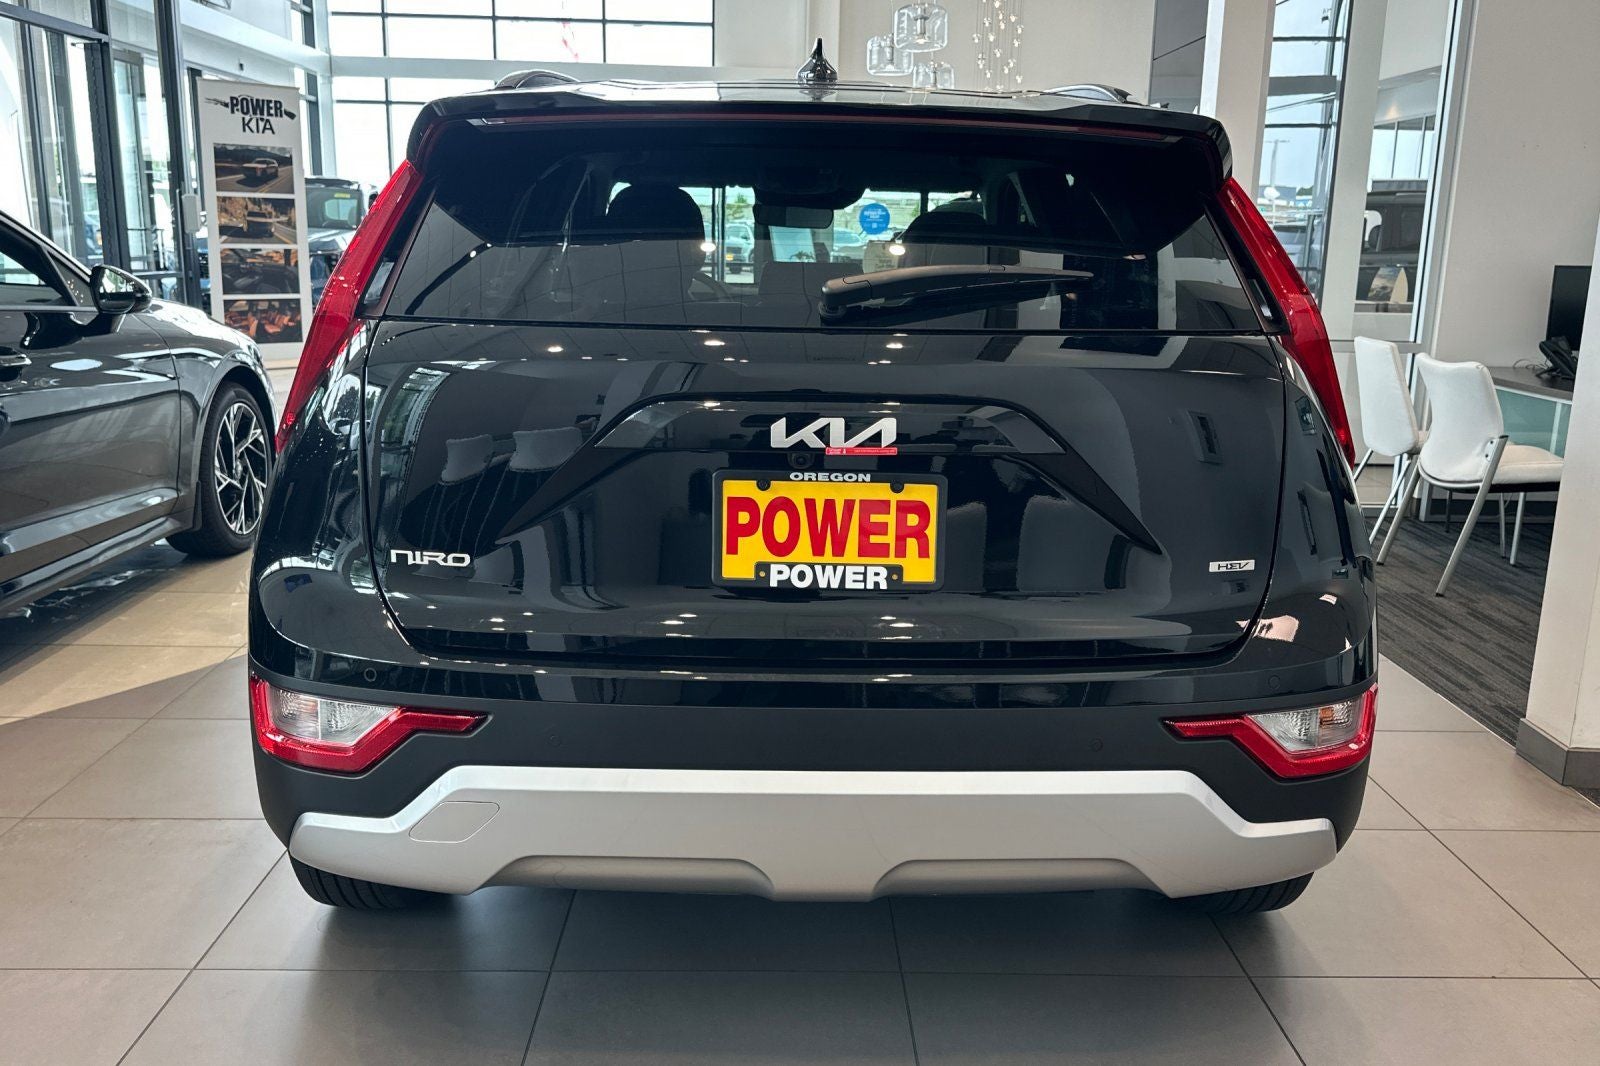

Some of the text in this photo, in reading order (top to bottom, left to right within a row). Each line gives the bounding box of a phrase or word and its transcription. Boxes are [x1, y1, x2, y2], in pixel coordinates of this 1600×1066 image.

[229, 96, 283, 118] POWER
[242, 116, 275, 135] KIA
[771, 417, 897, 448] KIA
[789, 472, 871, 482] OREGON
[726, 496, 931, 559] POWER
[769, 564, 888, 590] POWER
[1217, 561, 1250, 571] HEV
